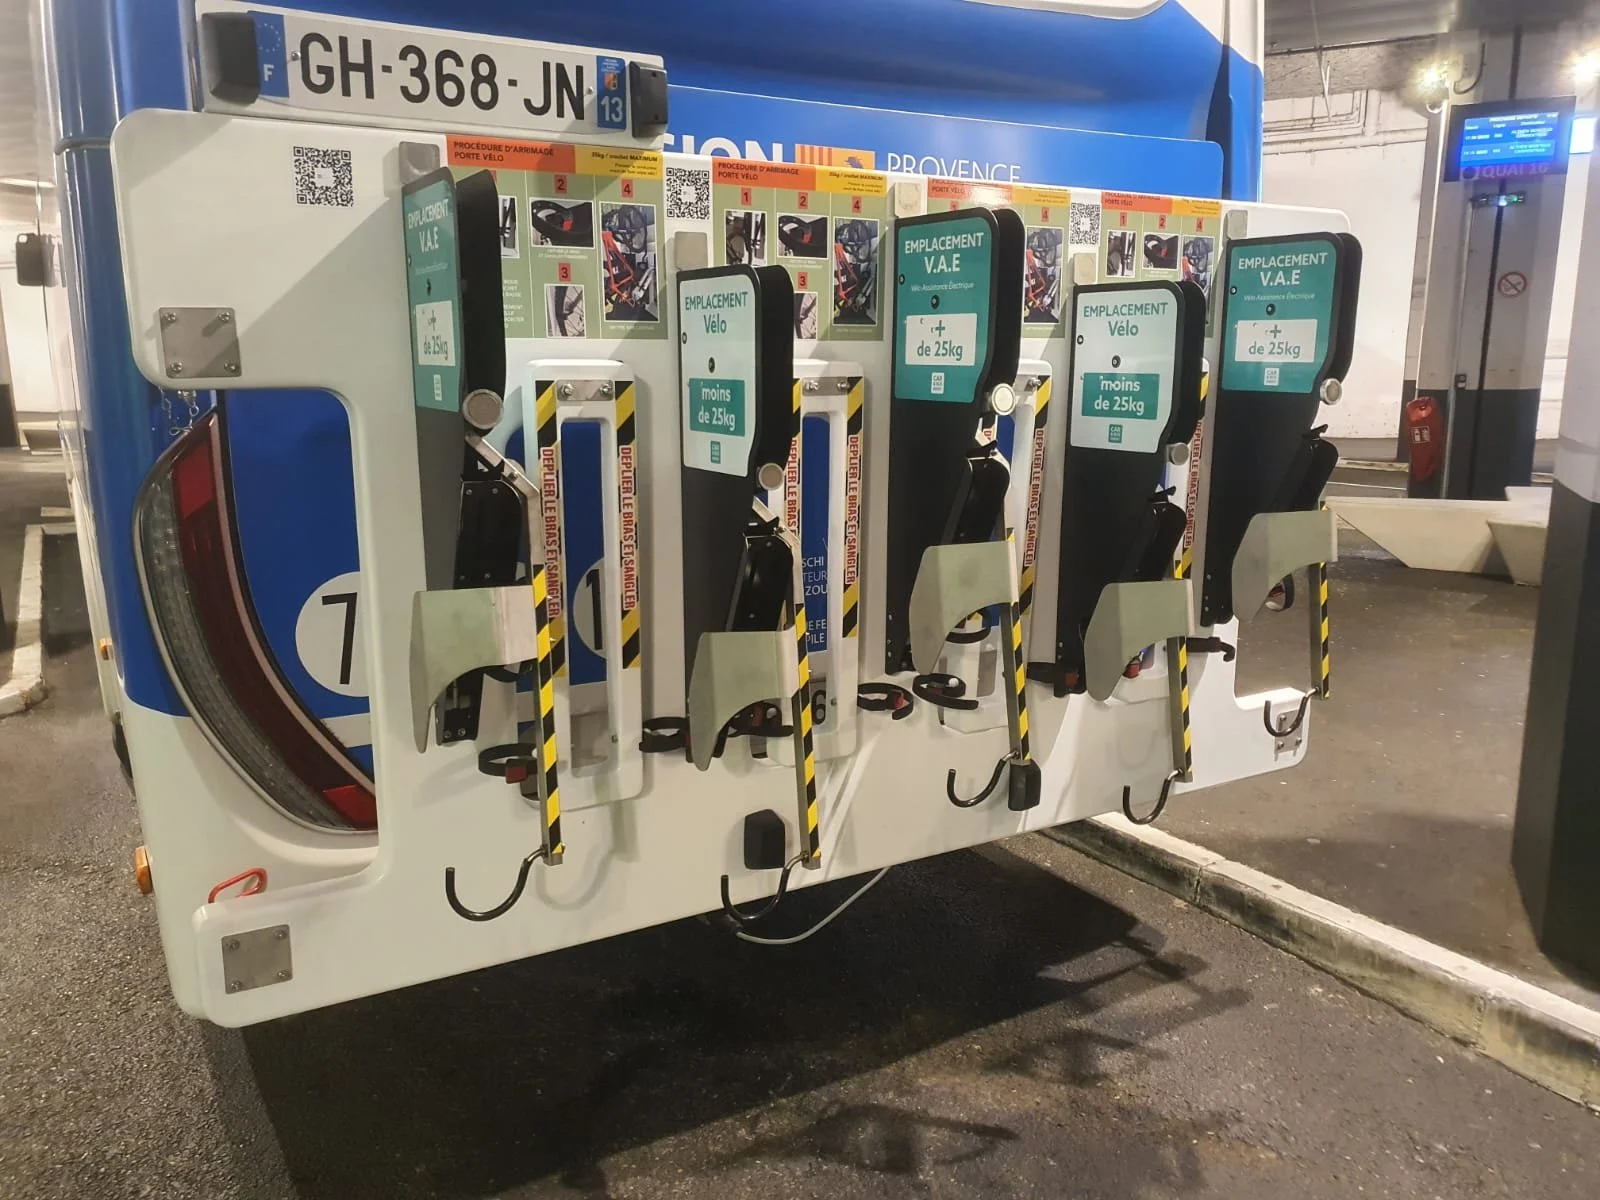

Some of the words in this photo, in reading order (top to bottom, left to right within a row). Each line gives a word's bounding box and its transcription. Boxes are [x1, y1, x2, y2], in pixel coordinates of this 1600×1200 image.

[263, 63, 273, 82] F
[300, 32, 585, 120] GH-368-JN
[600, 95, 623, 123] 13
[453, 141, 503, 152] PROCÉDURE
[504, 143, 554, 156] D'ARRIMAGE
[454, 151, 486, 161] PORTE
[488, 151, 504, 162] VÉLO
[718, 161, 757, 172] PROCÉDURE
[887, 152, 1021, 183] PROVENCE
[557, 178, 565, 191] 2
[718, 171, 743, 180] PORTE
[745, 171, 758, 181] VÉLO
[623, 183, 632, 195] 4
[743, 192, 749, 202] 1
[799, 196, 807, 206] 2
[853, 199, 860, 210] 4
[408, 199, 449, 229] EMPLACEMENT
[1042, 209, 1049, 219] 4
[1121, 215, 1126, 223] 1
[1160, 218, 1165, 227] 2
[1196, 221, 1202, 230] 4
[419, 227, 440, 253] V.A.E
[905, 232, 984, 254] EMPLACEMENT
[924, 254, 960, 274] V.A.E
[1238, 252, 1328, 270] EMPLACEMENT
[561, 267, 569, 279] 3
[800, 276, 806, 286] 3
[1260, 269, 1301, 287] V.A.E
[685, 291, 749, 311] EMPLACEMENT
[1083, 302, 1168, 318] EMPLACEMENT
[703, 313, 727, 334] Vélo
[935, 320, 946, 337] +
[1108, 320, 1139, 337] Vélo
[1269, 324, 1282, 339] +
[423, 334, 431, 355] de
[431, 333, 449, 360] 25kg
[917, 341, 931, 357] de
[934, 340, 963, 361] 25kg
[1248, 341, 1265, 355] de
[1267, 341, 1301, 359] 25kg
[1100, 376, 1141, 391] moins
[702, 387, 731, 402] moins
[1094, 395, 1110, 410] de
[1112, 397, 1145, 415] 25kg
[698, 406, 710, 424] de
[711, 407, 736, 431] 25kg
[849, 436, 858, 479] DEPLIER
[1033, 430, 1044, 469] DEPLIER
[542, 448, 557, 497] DEPLIER
[621, 447, 633, 494] DEPLIER
[1191, 459, 1199, 470] LE
[1032, 471, 1041, 482] LE
[1189, 471, 1198, 494] BRAS
[788, 485, 797, 497] LE
[848, 481, 858, 493] LE
[622, 497, 634, 509] LE
[1030, 484, 1040, 509] BRAS
[544, 500, 558, 512] LE
[788, 499, 797, 527] BRAS
[848, 495, 858, 522] BRAS
[1029, 511, 1038, 521] ET
[545, 516, 558, 545] BRAS
[622, 512, 634, 541] BRAS
[847, 524, 857, 535] ET
[623, 545, 635, 556] ET
[1025, 524, 1037, 565] SANGLER
[546, 549, 559, 562] ET
[847, 538, 857, 583] SANGLER
[623, 559, 636, 608] SANGLER
[586, 569, 603, 651] 1
[322, 593, 357, 685] 7
